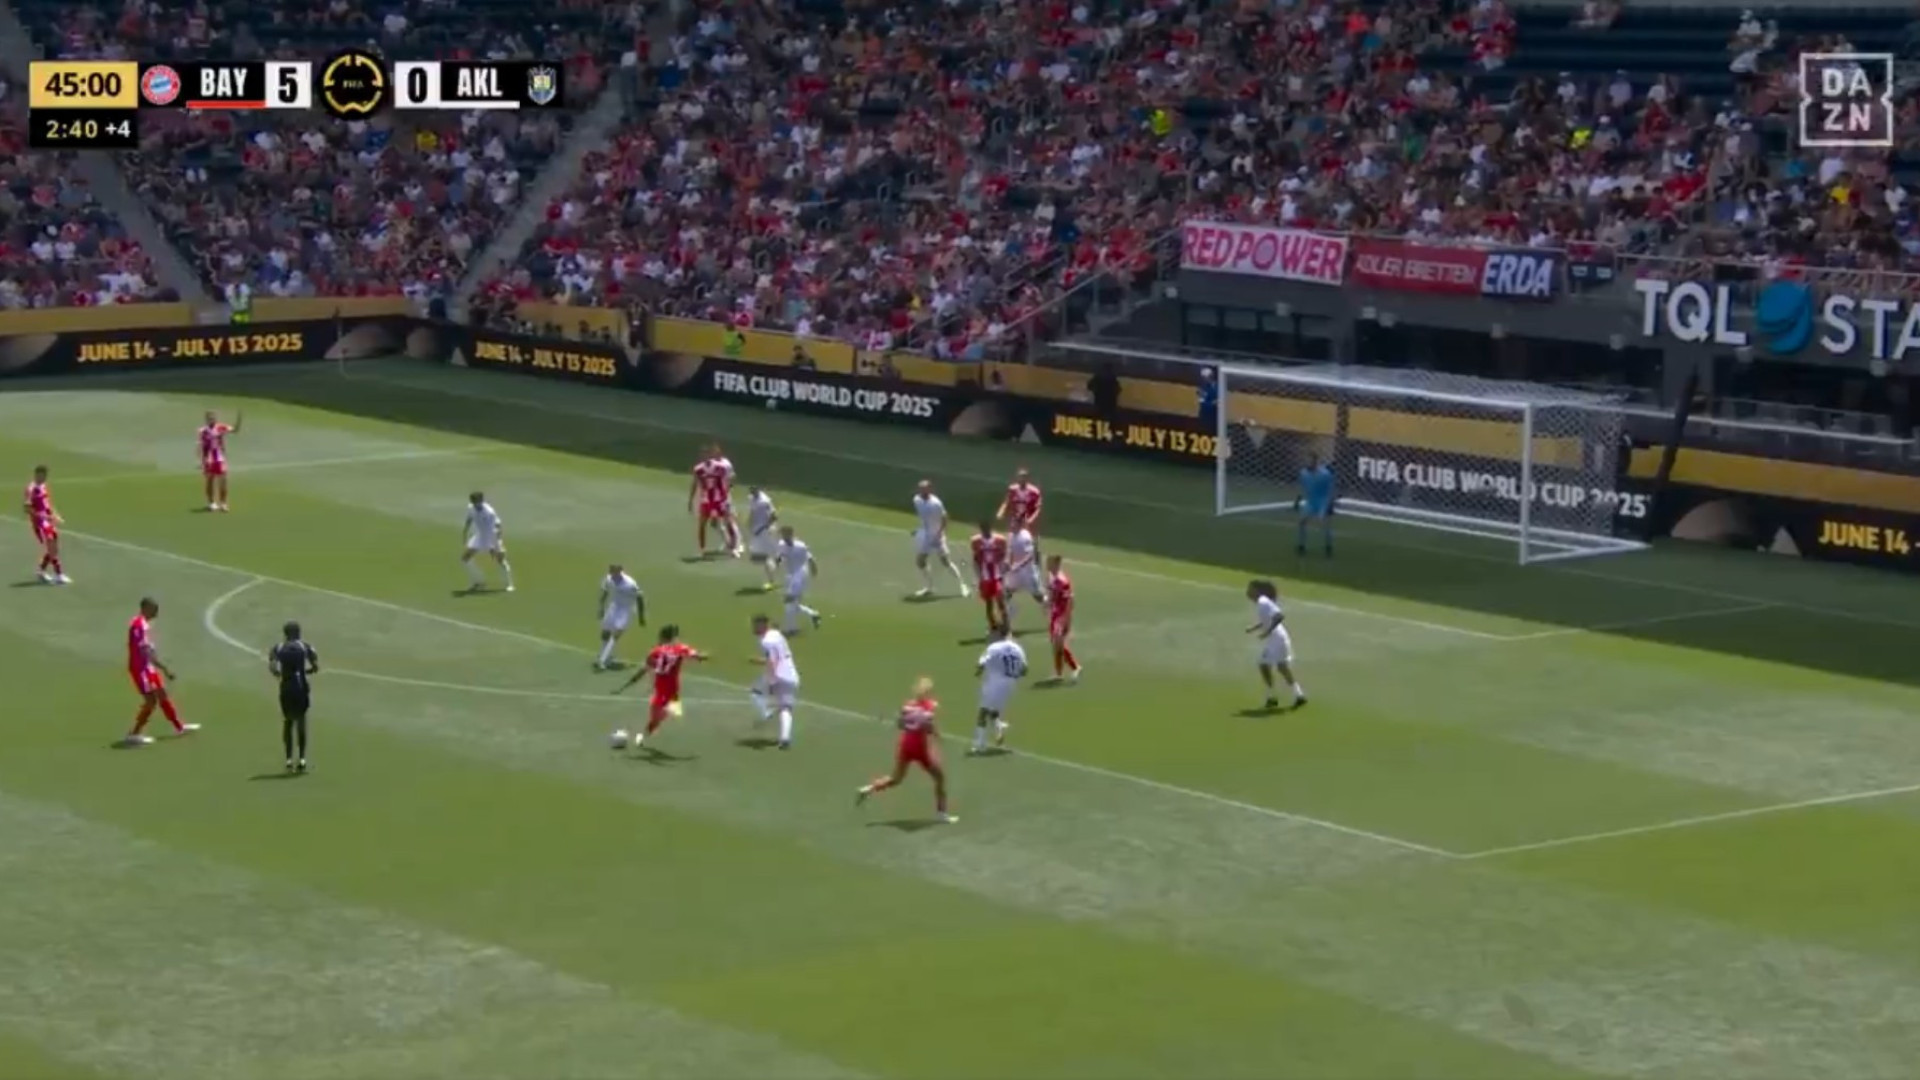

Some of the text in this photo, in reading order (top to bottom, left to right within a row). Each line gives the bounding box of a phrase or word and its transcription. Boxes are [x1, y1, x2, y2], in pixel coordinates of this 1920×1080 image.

[1183, 226, 1343, 281] RED POWER
[1481, 254, 1555, 297] ERDA
[1635, 278, 1747, 345] TQL
[77, 342, 130, 363] JUNE
[134, 341, 156, 360] 14
[172, 337, 224, 358] JULY
[228, 336, 249, 354] 13
[252, 333, 304, 352] 2025
[475, 341, 507, 362] JUNE
[508, 345, 523, 364] 14
[532, 348, 565, 370] JULY
[566, 353, 581, 372] 13
[582, 356, 617, 377] 2025
[713, 370, 749, 394] FIFA
[750, 373, 790, 399] CLUB
[792, 380, 852, 407] WORLD
[854, 389, 888, 411] CUP
[1052, 414, 1093, 438] JUNE
[1096, 419, 1113, 442] 14
[1126, 424, 1167, 449] JULY
[1169, 430, 1187, 452] 13
[1357, 456, 1399, 483] FIFA
[1403, 462, 1456, 490] CLUB
[1541, 481, 1586, 508] CUP
[1818, 520, 1910, 555] JUNE 14
